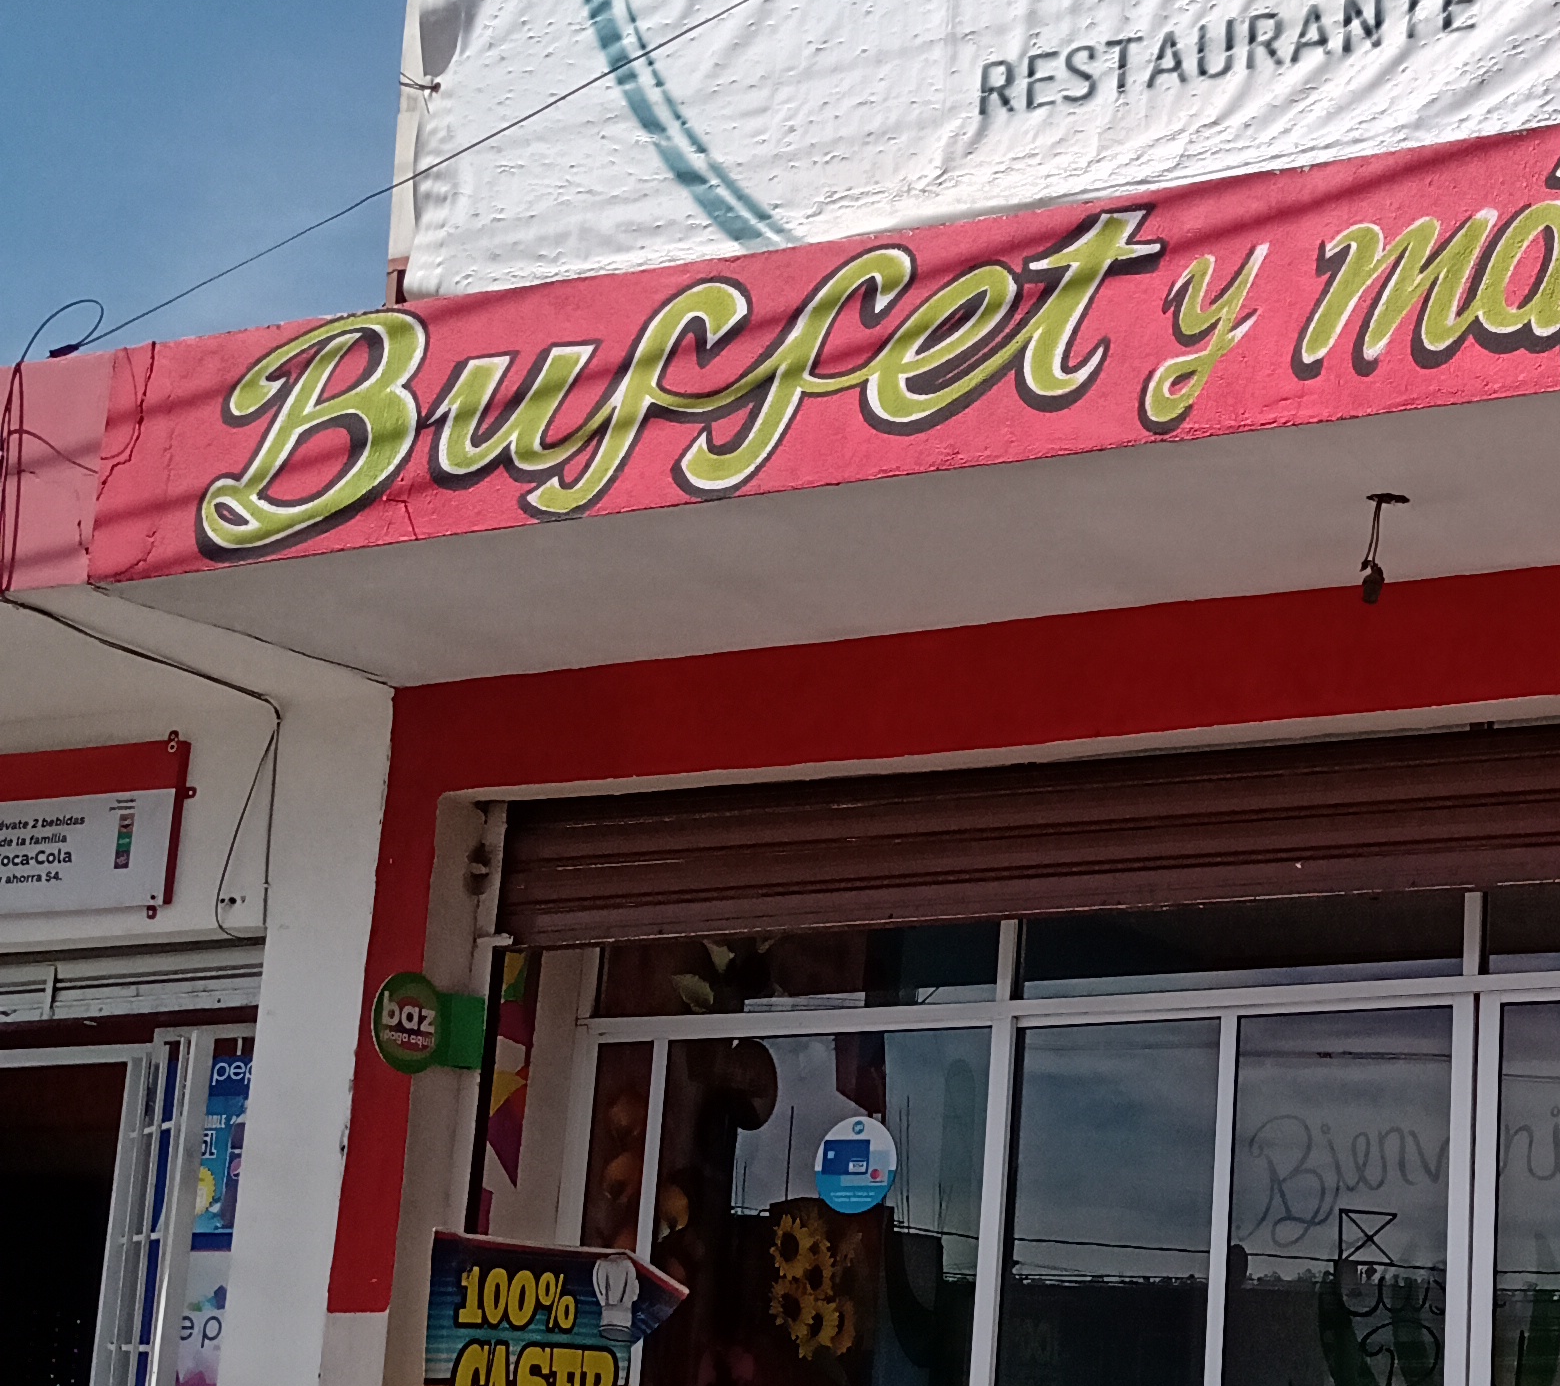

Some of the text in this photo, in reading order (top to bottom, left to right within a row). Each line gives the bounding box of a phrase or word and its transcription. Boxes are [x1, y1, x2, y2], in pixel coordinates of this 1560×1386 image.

[196, 204, 1166, 562] Buffet
[1139, 243, 1269, 435] y
[31, 818, 39, 829] 2
[41, 815, 86, 828] bebidas
[16, 836, 26, 846] la
[29, 832, 67, 845] familia
[0, 848, 72, 867] oca-Cola
[5, 873, 42, 884] ahorra
[382, 990, 436, 1033] baz
[458, 1266, 577, 1329] 100%
